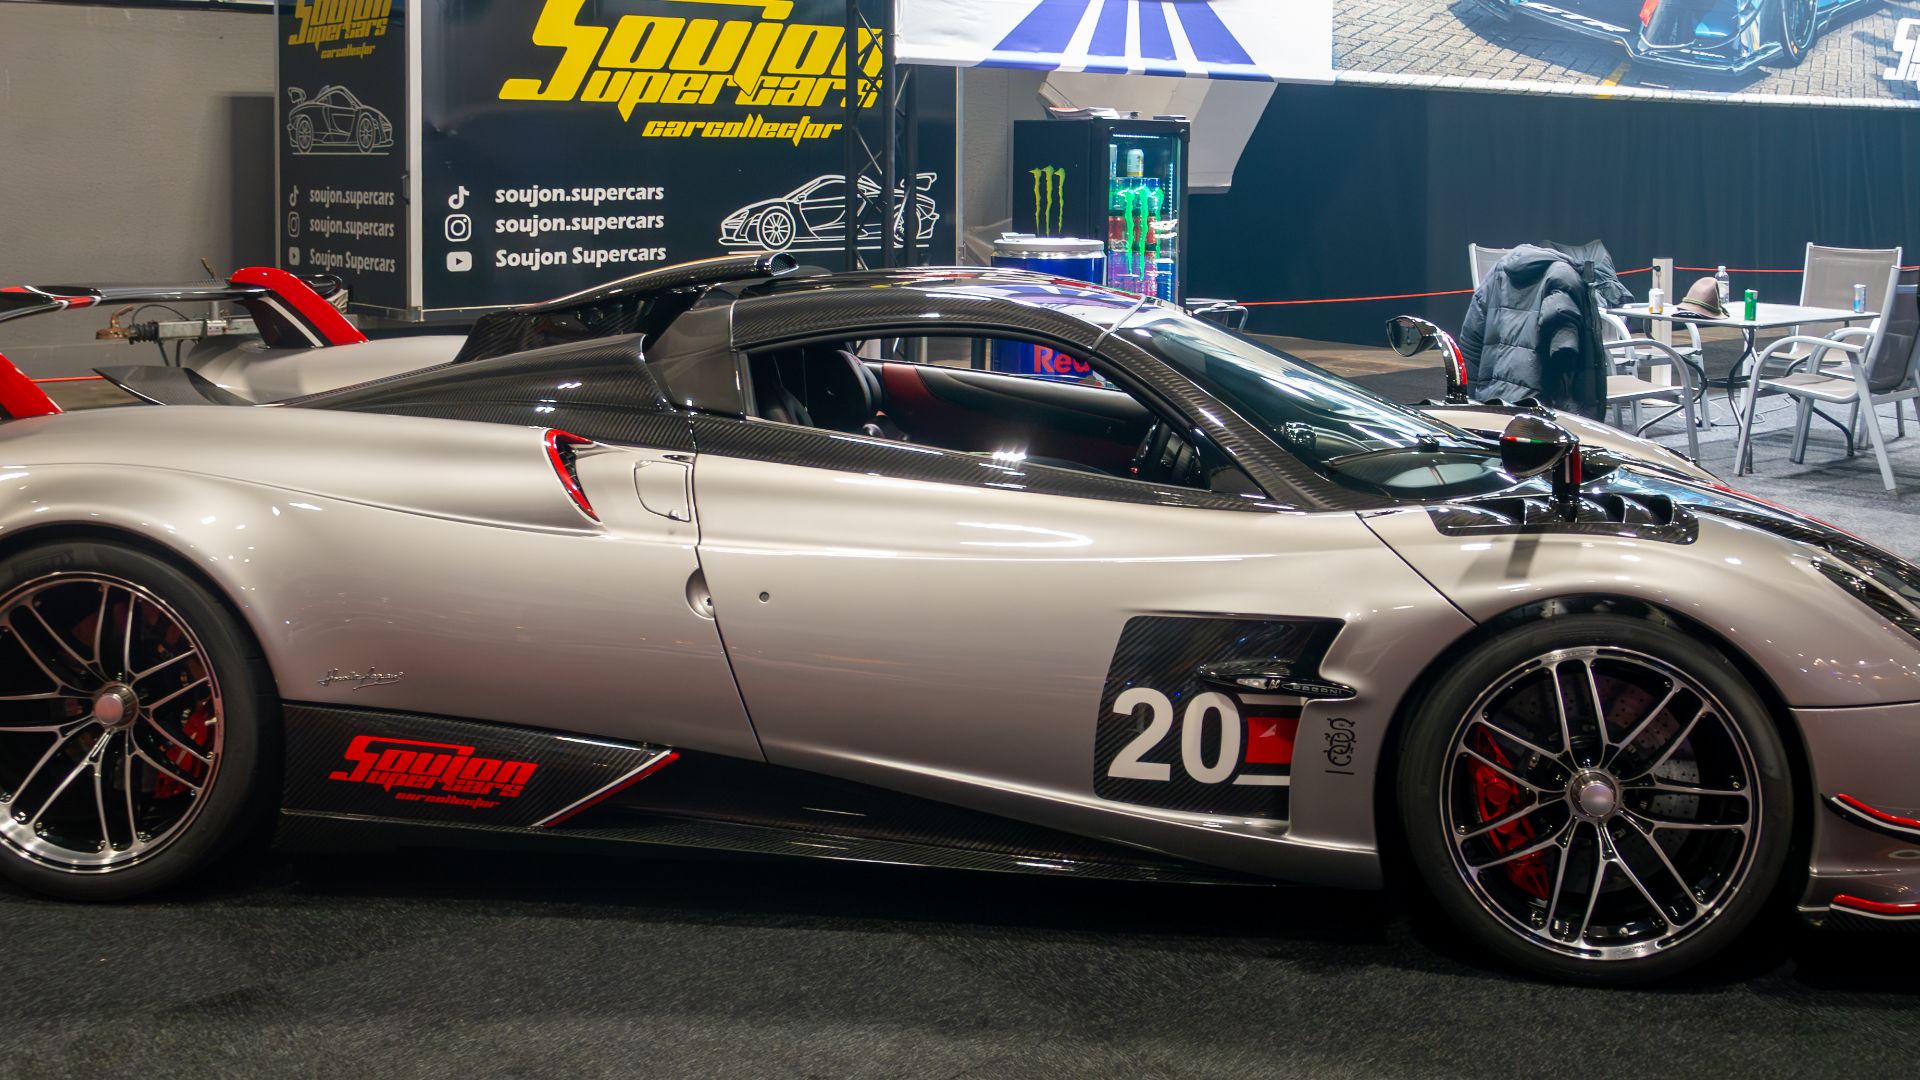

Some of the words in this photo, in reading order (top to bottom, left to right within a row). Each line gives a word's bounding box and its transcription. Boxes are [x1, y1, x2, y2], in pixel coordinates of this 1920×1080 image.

[642, 113, 843, 147] carcollector
[310, 186, 395, 209] soujon.supercars
[495, 185, 664, 207] soujon.supercars
[310, 216, 395, 240] soujon.supercars
[495, 214, 665, 237] soujon.supercars
[310, 248, 343, 271] Soujon
[345, 251, 396, 275] Supercars
[496, 248, 567, 271] Soujon
[572, 247, 667, 268] Supercars
[1108, 687, 1241, 784] 20
[329, 735, 539, 785] Soujon
